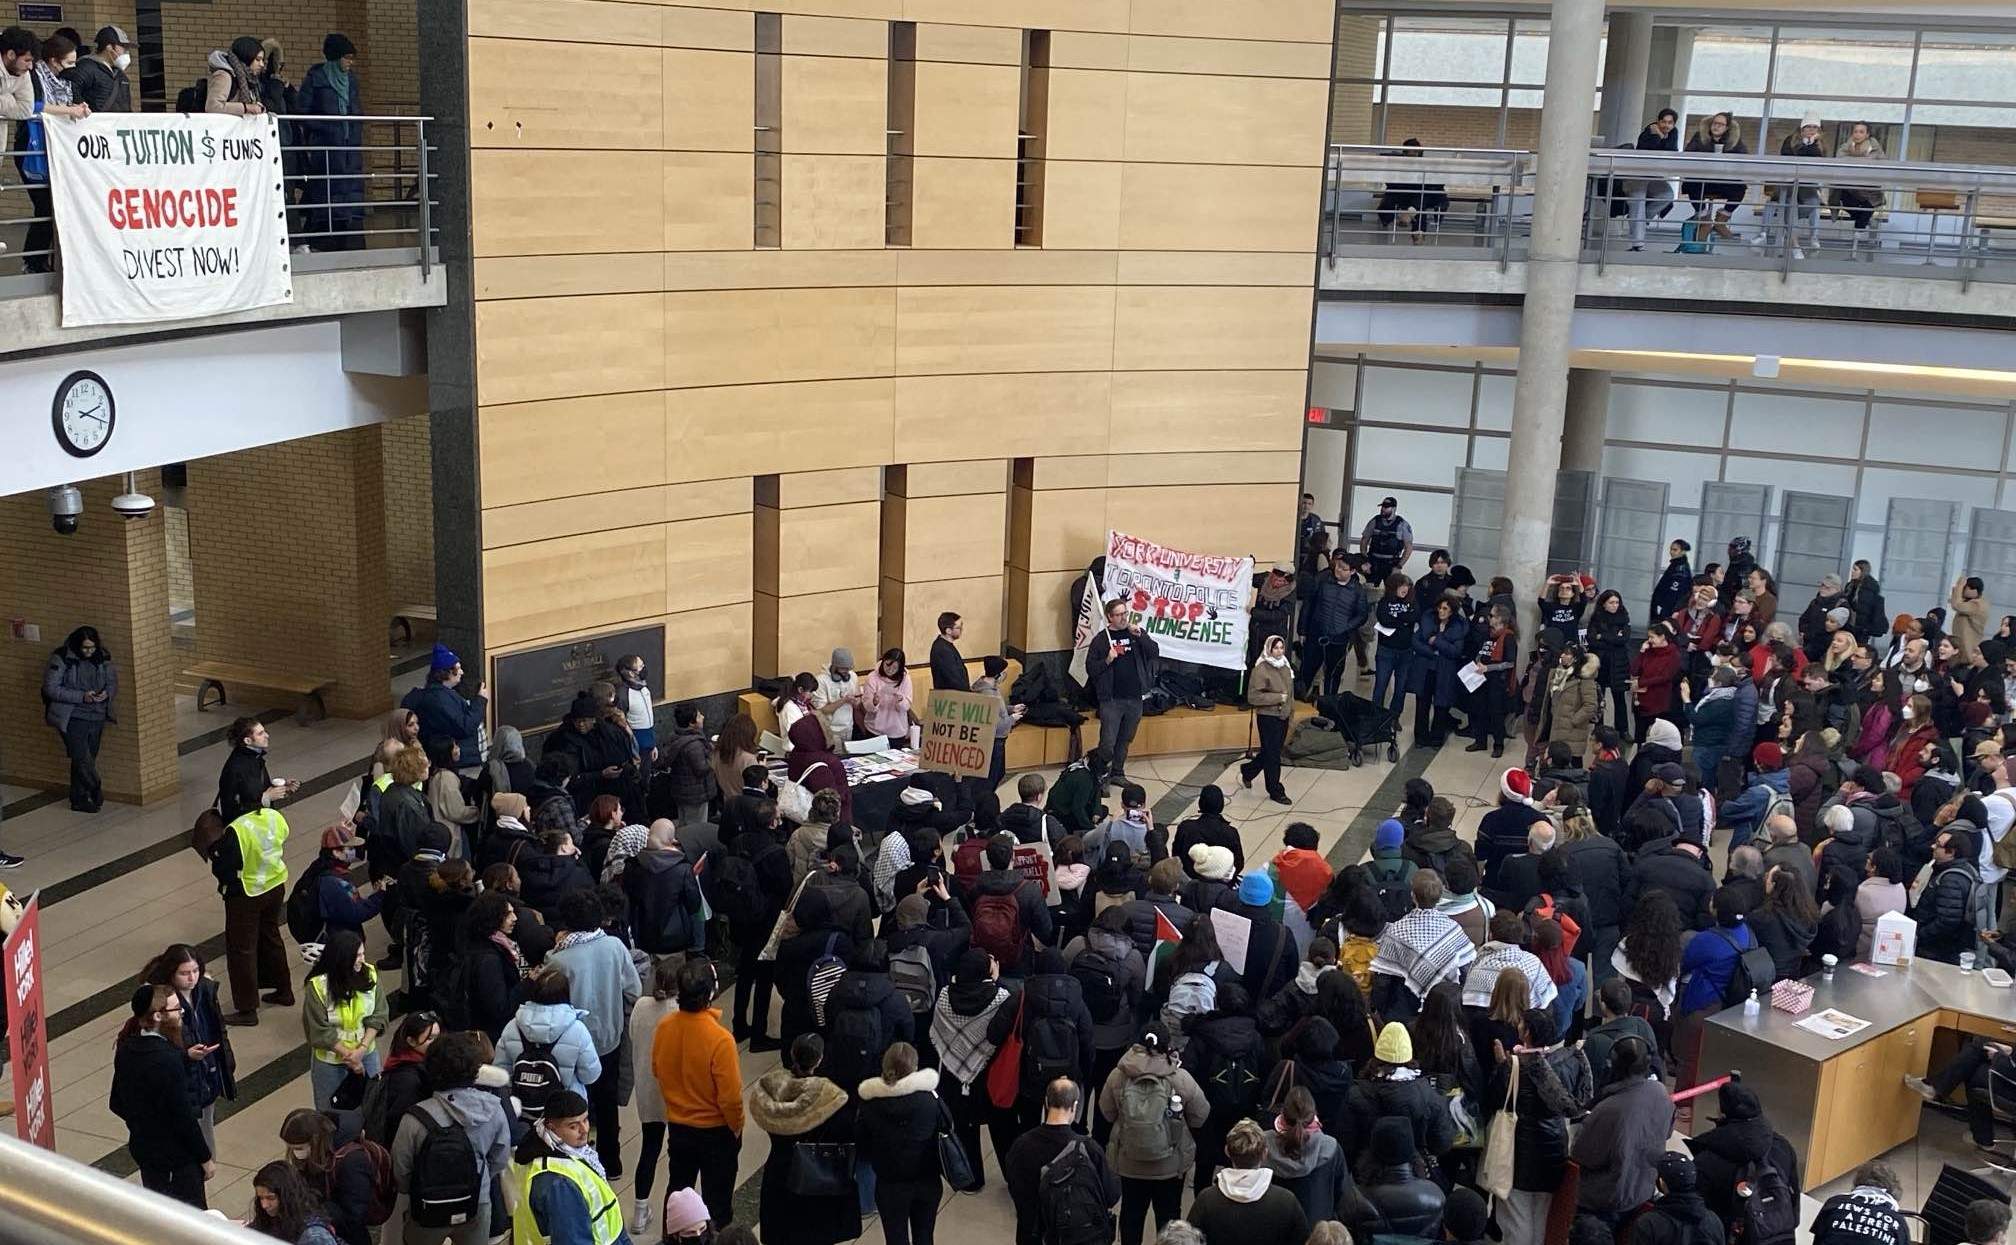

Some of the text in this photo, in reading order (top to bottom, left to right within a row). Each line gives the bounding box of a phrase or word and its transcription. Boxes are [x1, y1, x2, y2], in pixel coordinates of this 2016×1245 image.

[77, 135, 111, 160] OUR
[116, 129, 195, 165] TUITION
[201, 129, 216, 164] $
[107, 188, 238, 230] GENOCIDE
[123, 246, 239, 280] DIVEST NOW!
[1110, 531, 1244, 582] YORK UNIVERSITY
[1107, 563, 1240, 611] TORONTO POLICE
[1132, 589, 1204, 622] STOP
[1146, 616, 1234, 645] NONSENSE
[934, 699, 992, 725] WE WILL
[932, 721, 980, 743] NOT BE
[924, 740, 985, 770] SILENCED
[1837, 1203, 1900, 1230] JEWS FOR
[1844, 1212, 1890, 1231] A FREE
